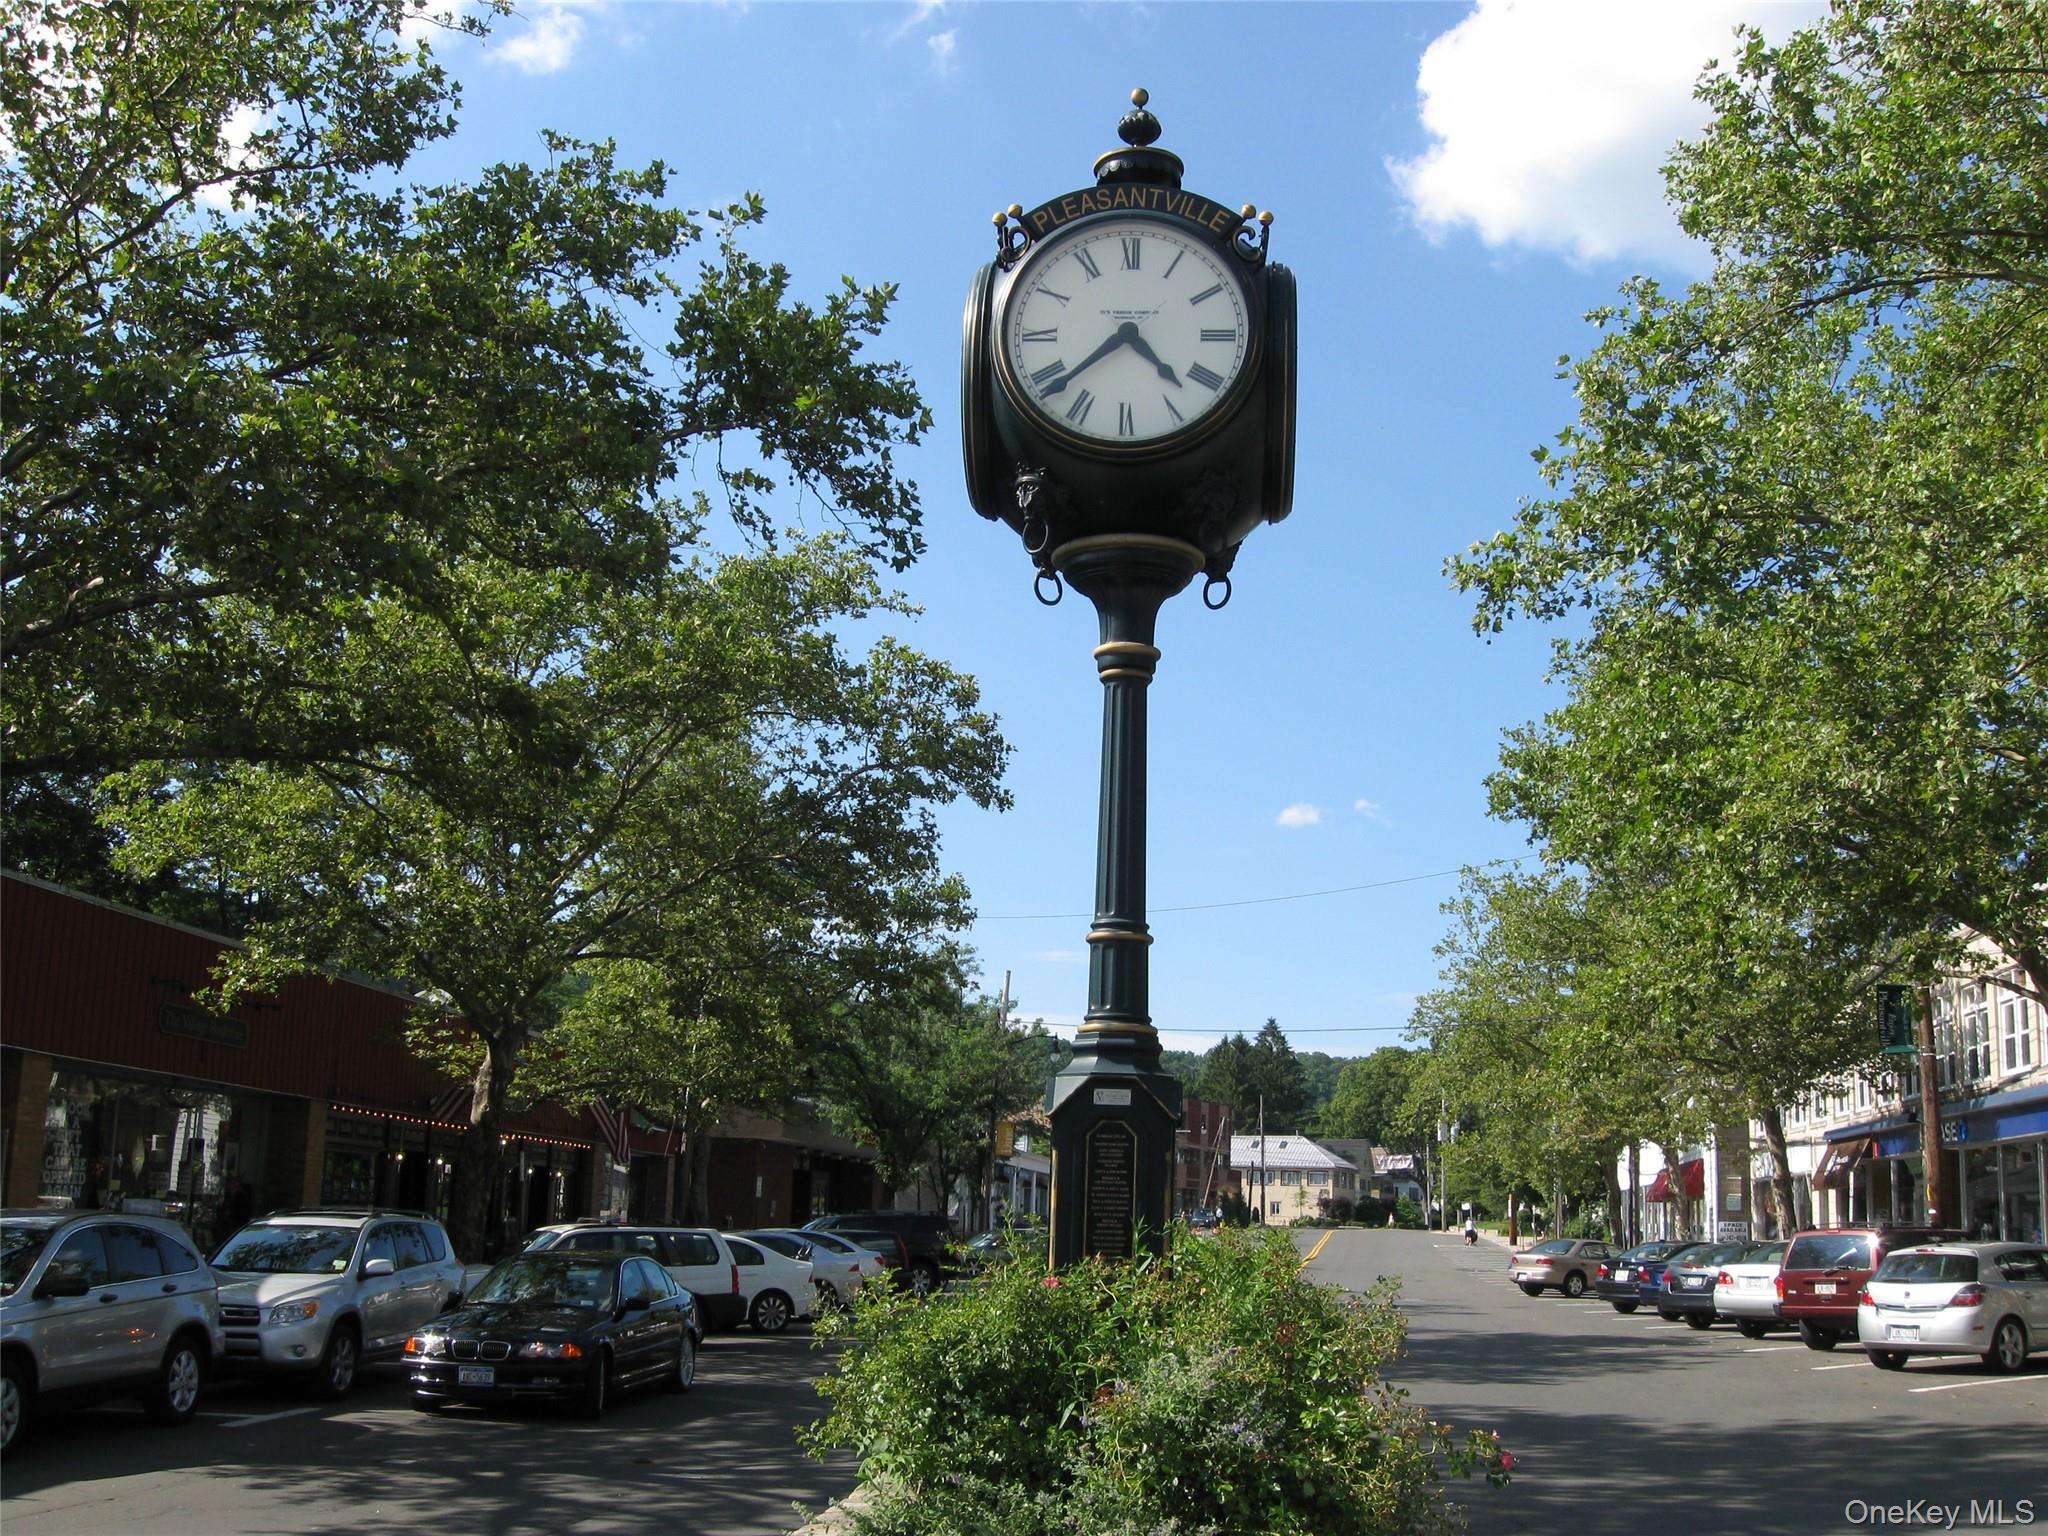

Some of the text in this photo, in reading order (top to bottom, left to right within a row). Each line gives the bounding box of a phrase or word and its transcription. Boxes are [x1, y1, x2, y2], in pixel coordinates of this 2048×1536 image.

[1033, 186, 1230, 233] PLEASANTVILLE
[1121, 238, 1141, 270] XII
[1189, 283, 1224, 306] II
[1200, 328, 1237, 342] III
[1186, 361, 1226, 392] IIII
[1163, 394, 1185, 426] V
[52, 1142, 82, 1157] THAT
[72, 1158, 88, 1171] BE
[42, 1170, 87, 1185] OPENED
[47, 1184, 82, 1199] AGAIN
